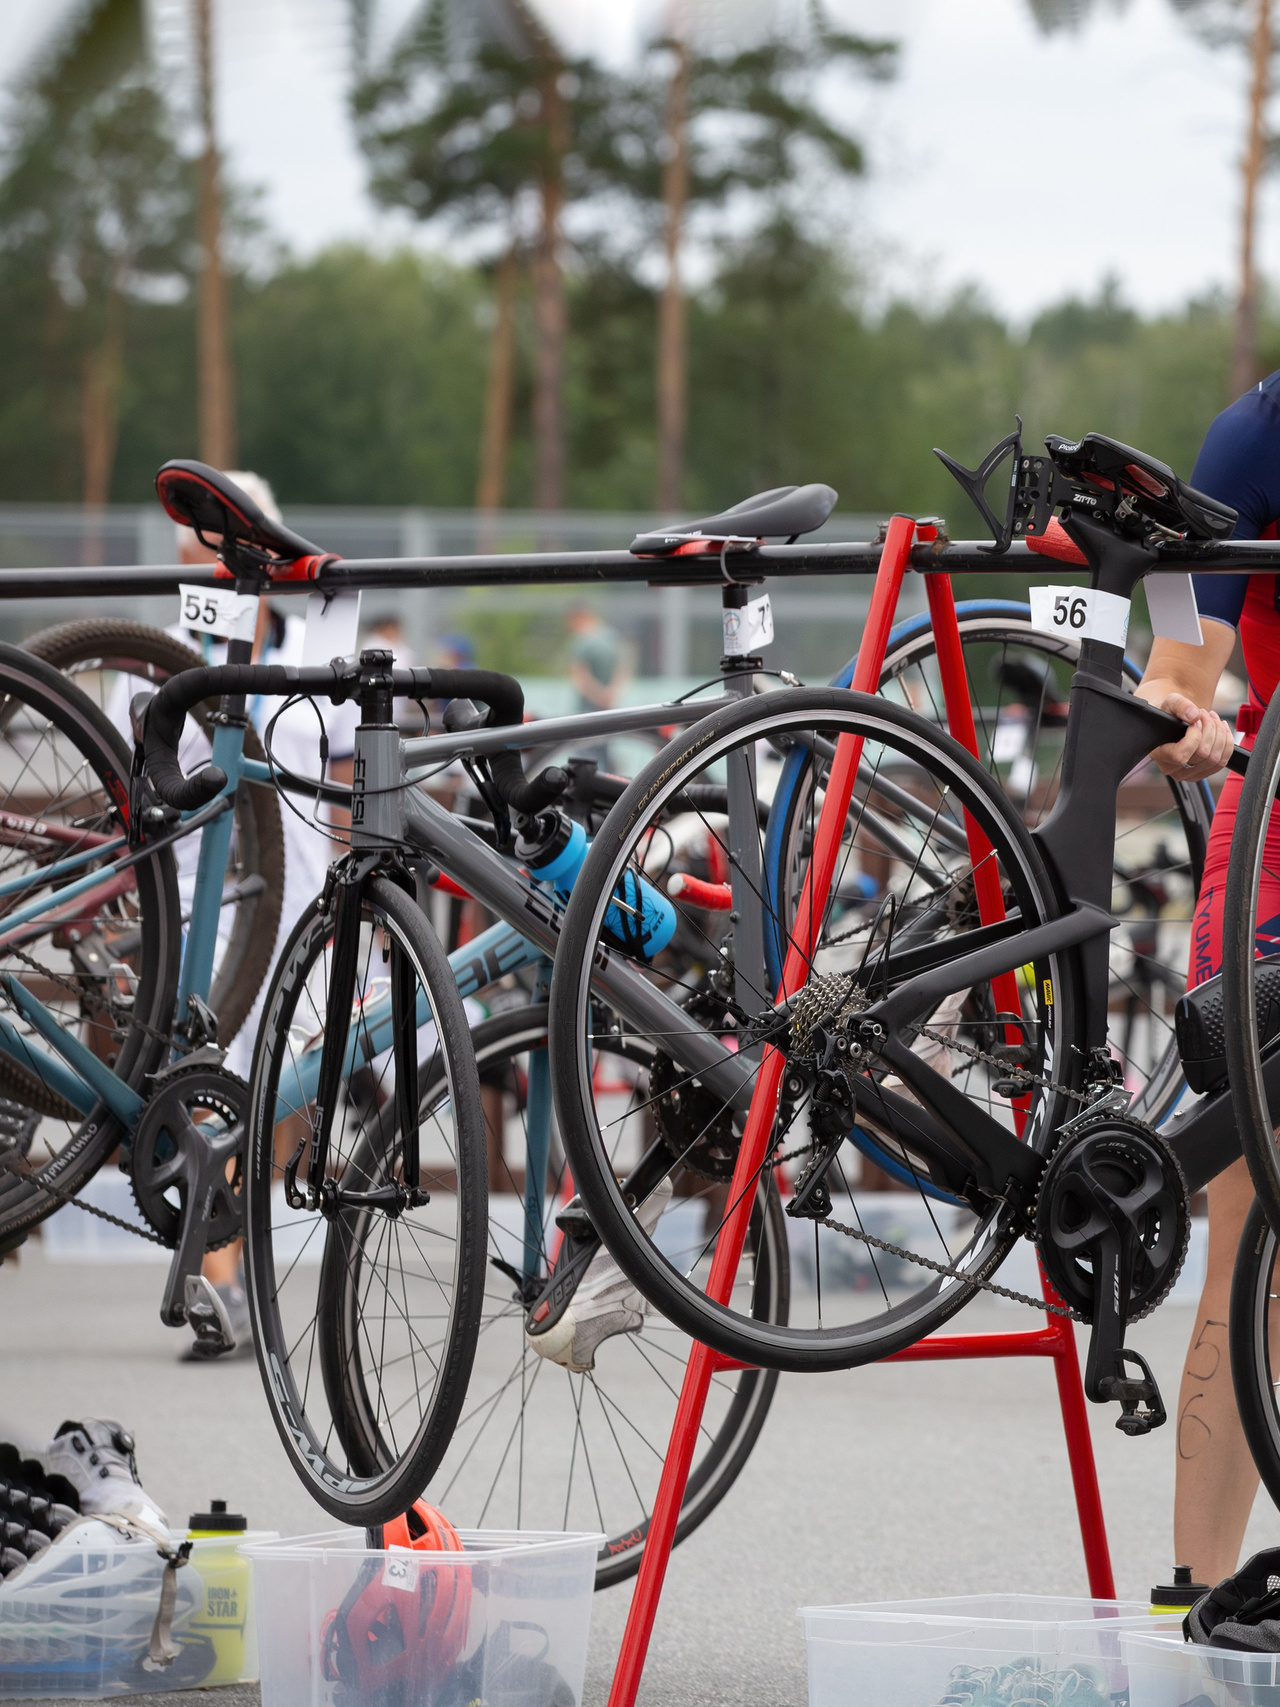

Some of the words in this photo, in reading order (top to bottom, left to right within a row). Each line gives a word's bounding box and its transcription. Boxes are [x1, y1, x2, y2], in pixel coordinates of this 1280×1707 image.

[184, 594, 218, 624] 55
[757, 603, 772, 634] 7
[1053, 595, 1087, 629] 56
[1195, 885, 1214, 987] TYUME
[1044, 981, 1052, 1004] MAVIC
[207, 1587, 230, 1600] IRON
[206, 1601, 238, 1617] STAR
